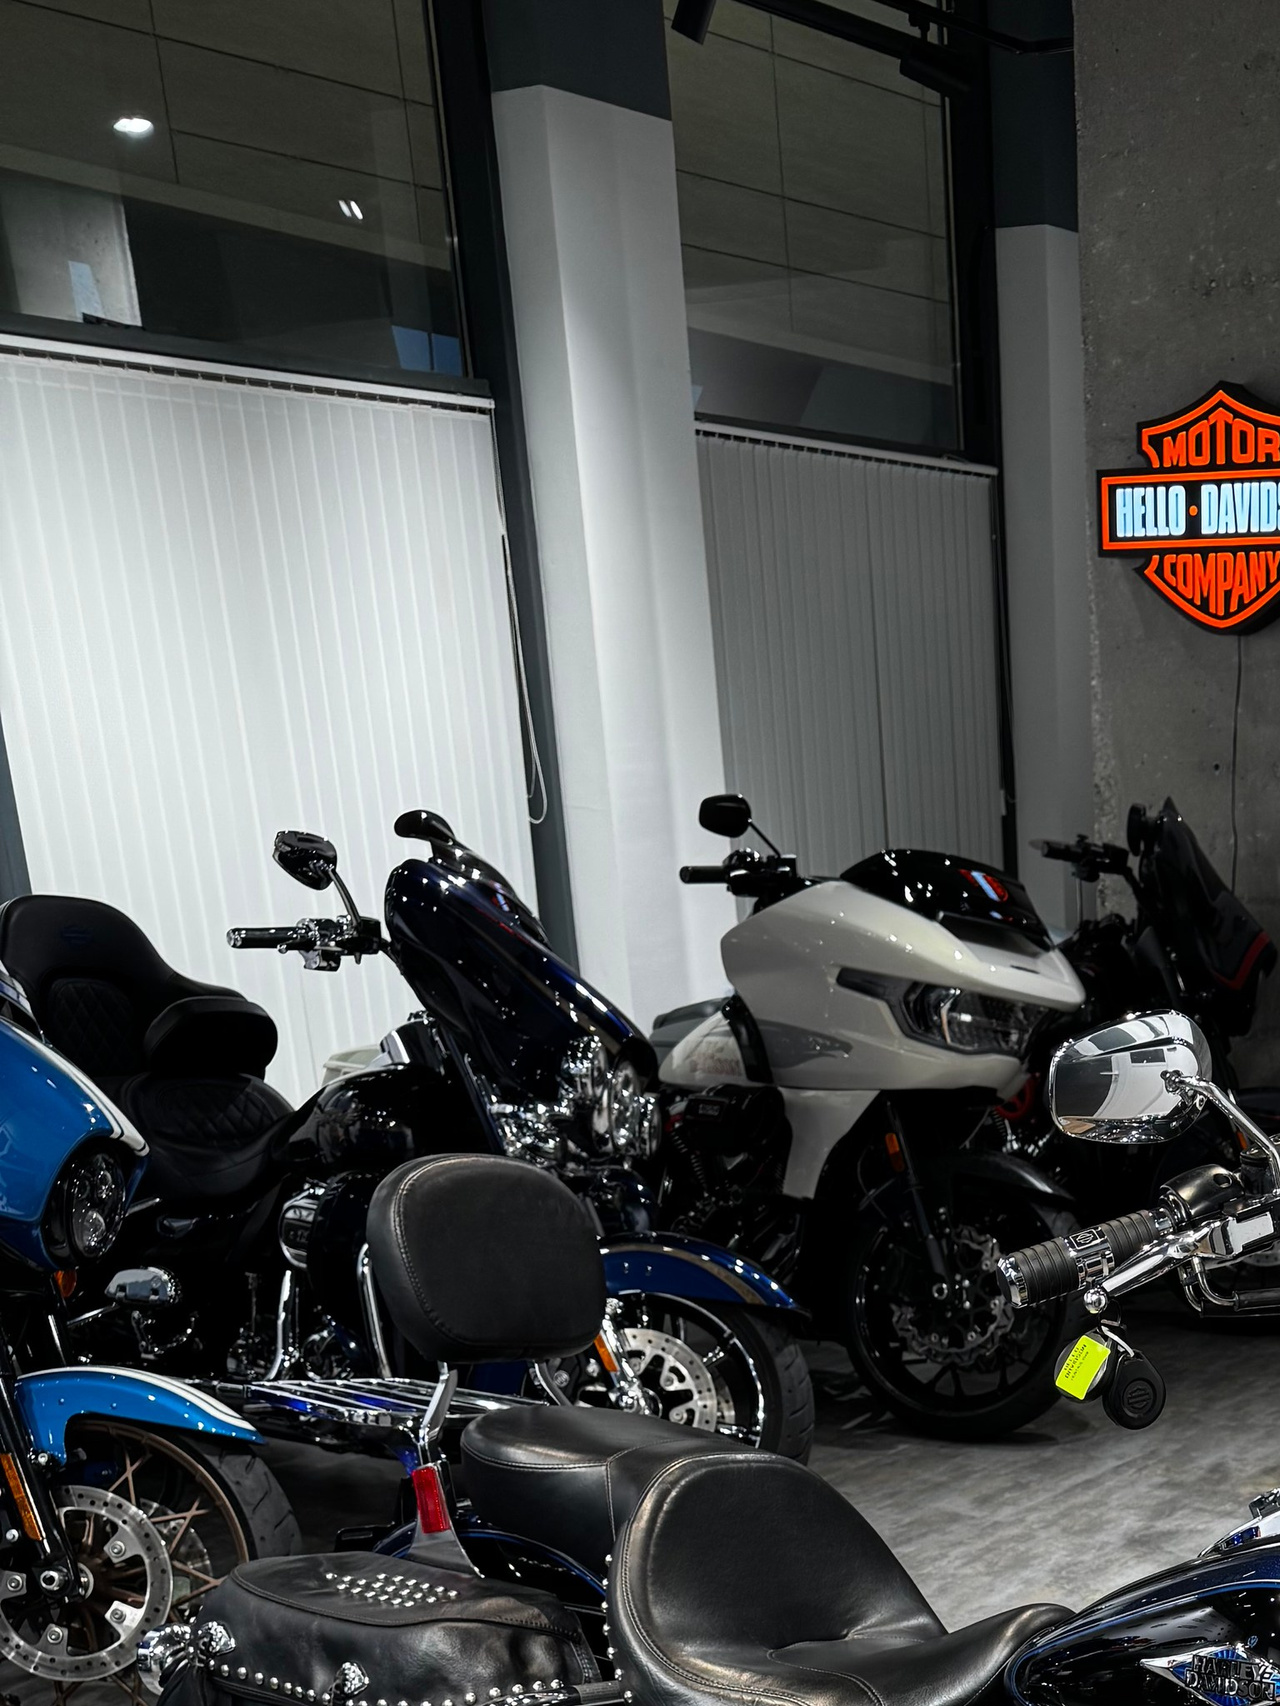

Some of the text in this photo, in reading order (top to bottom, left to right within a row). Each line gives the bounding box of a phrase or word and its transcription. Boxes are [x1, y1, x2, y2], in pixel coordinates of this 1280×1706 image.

[1162, 407, 1280, 468] MOTOR
[1115, 485, 1187, 538] HELLO
[1184, 1667, 1276, 1702] DAVIDSON
